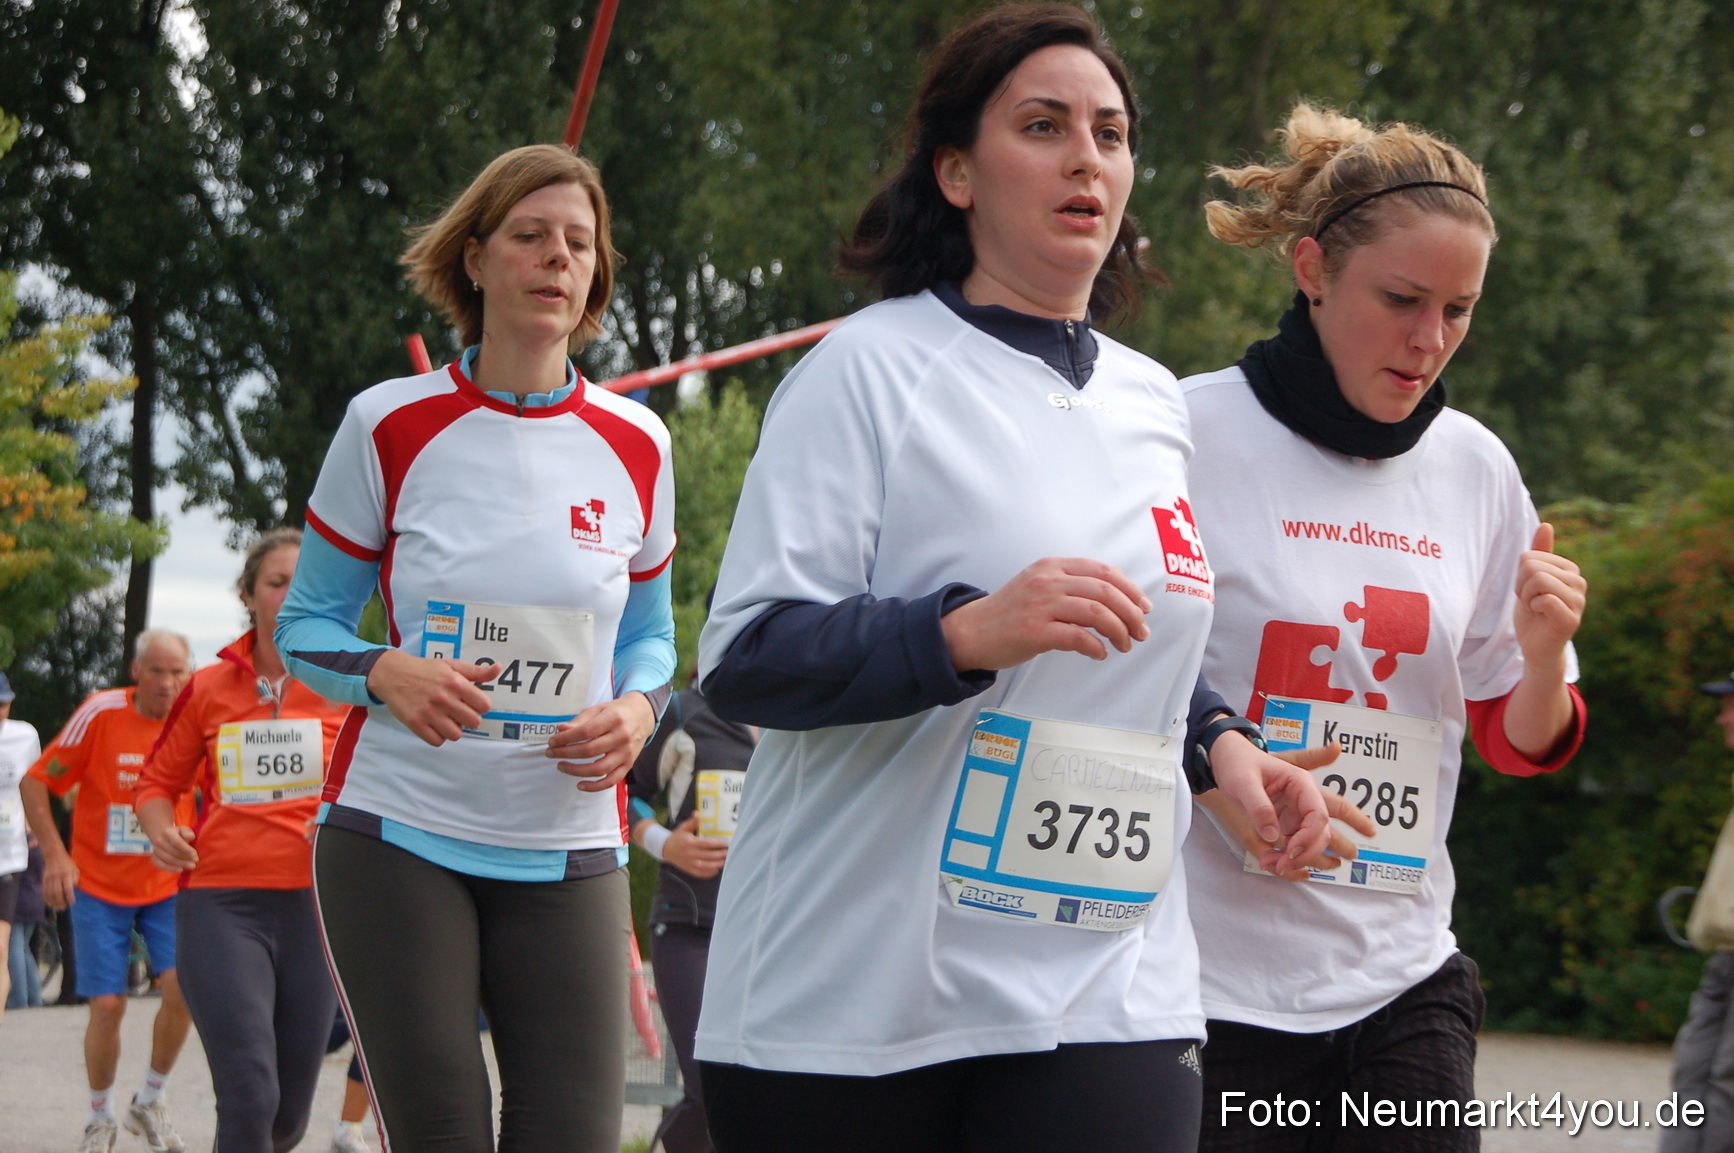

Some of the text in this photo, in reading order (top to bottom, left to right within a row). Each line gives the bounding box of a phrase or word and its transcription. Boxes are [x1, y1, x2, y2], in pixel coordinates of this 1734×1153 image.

[572, 527, 601, 542] DKMS
[1281, 519, 1443, 559] www.dkms.de
[1165, 552, 1208, 581] DKMS
[1165, 582, 1186, 593] JEDER
[474, 616, 509, 643] Ute
[473, 656, 574, 697] 2477
[244, 727, 303, 746] Michaela
[1323, 720, 1398, 761] Kerstin
[256, 752, 304, 777] 568
[1026, 800, 1151, 863] 3735
[959, 885, 1024, 909] BOCK
